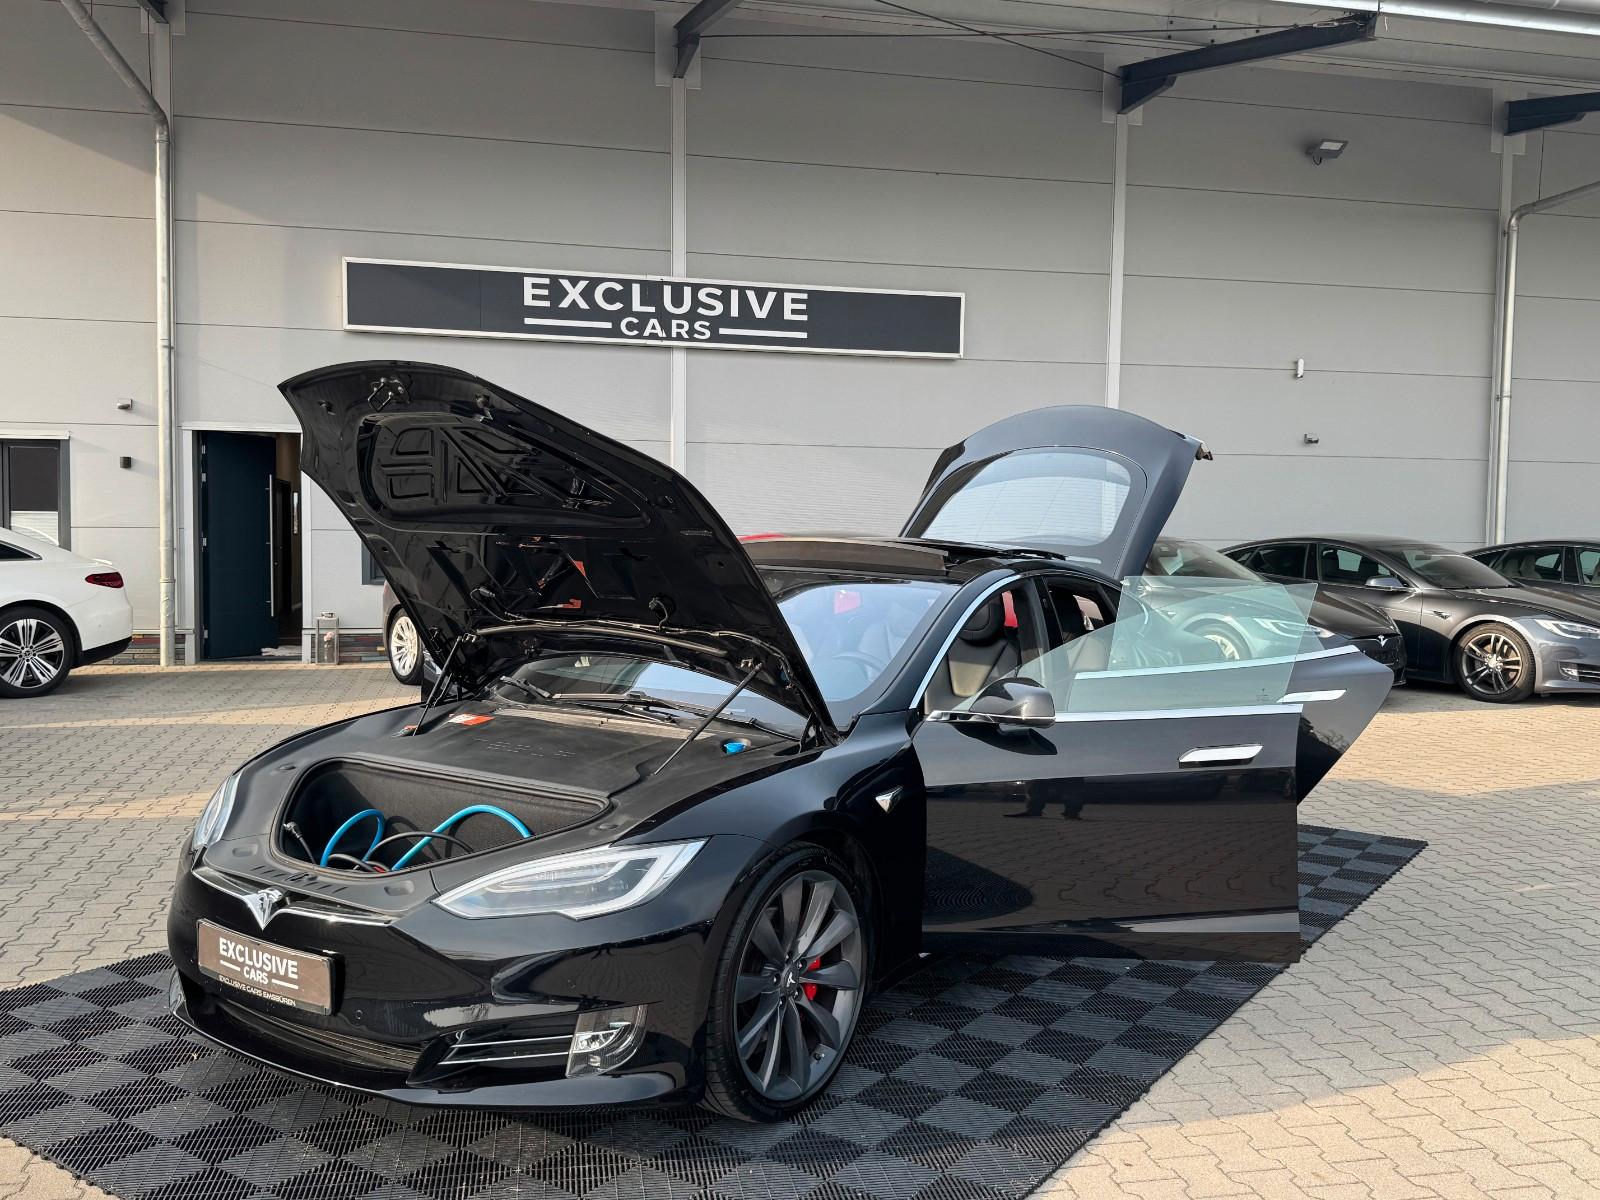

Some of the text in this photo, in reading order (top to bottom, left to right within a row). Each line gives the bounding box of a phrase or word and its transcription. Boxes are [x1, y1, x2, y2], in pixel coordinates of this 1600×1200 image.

[523, 276, 808, 321] EXCLUSIVE
[620, 317, 711, 340] CARS
[219, 937, 299, 979] EXCLUSIVE
[243, 966, 269, 985] CARS
